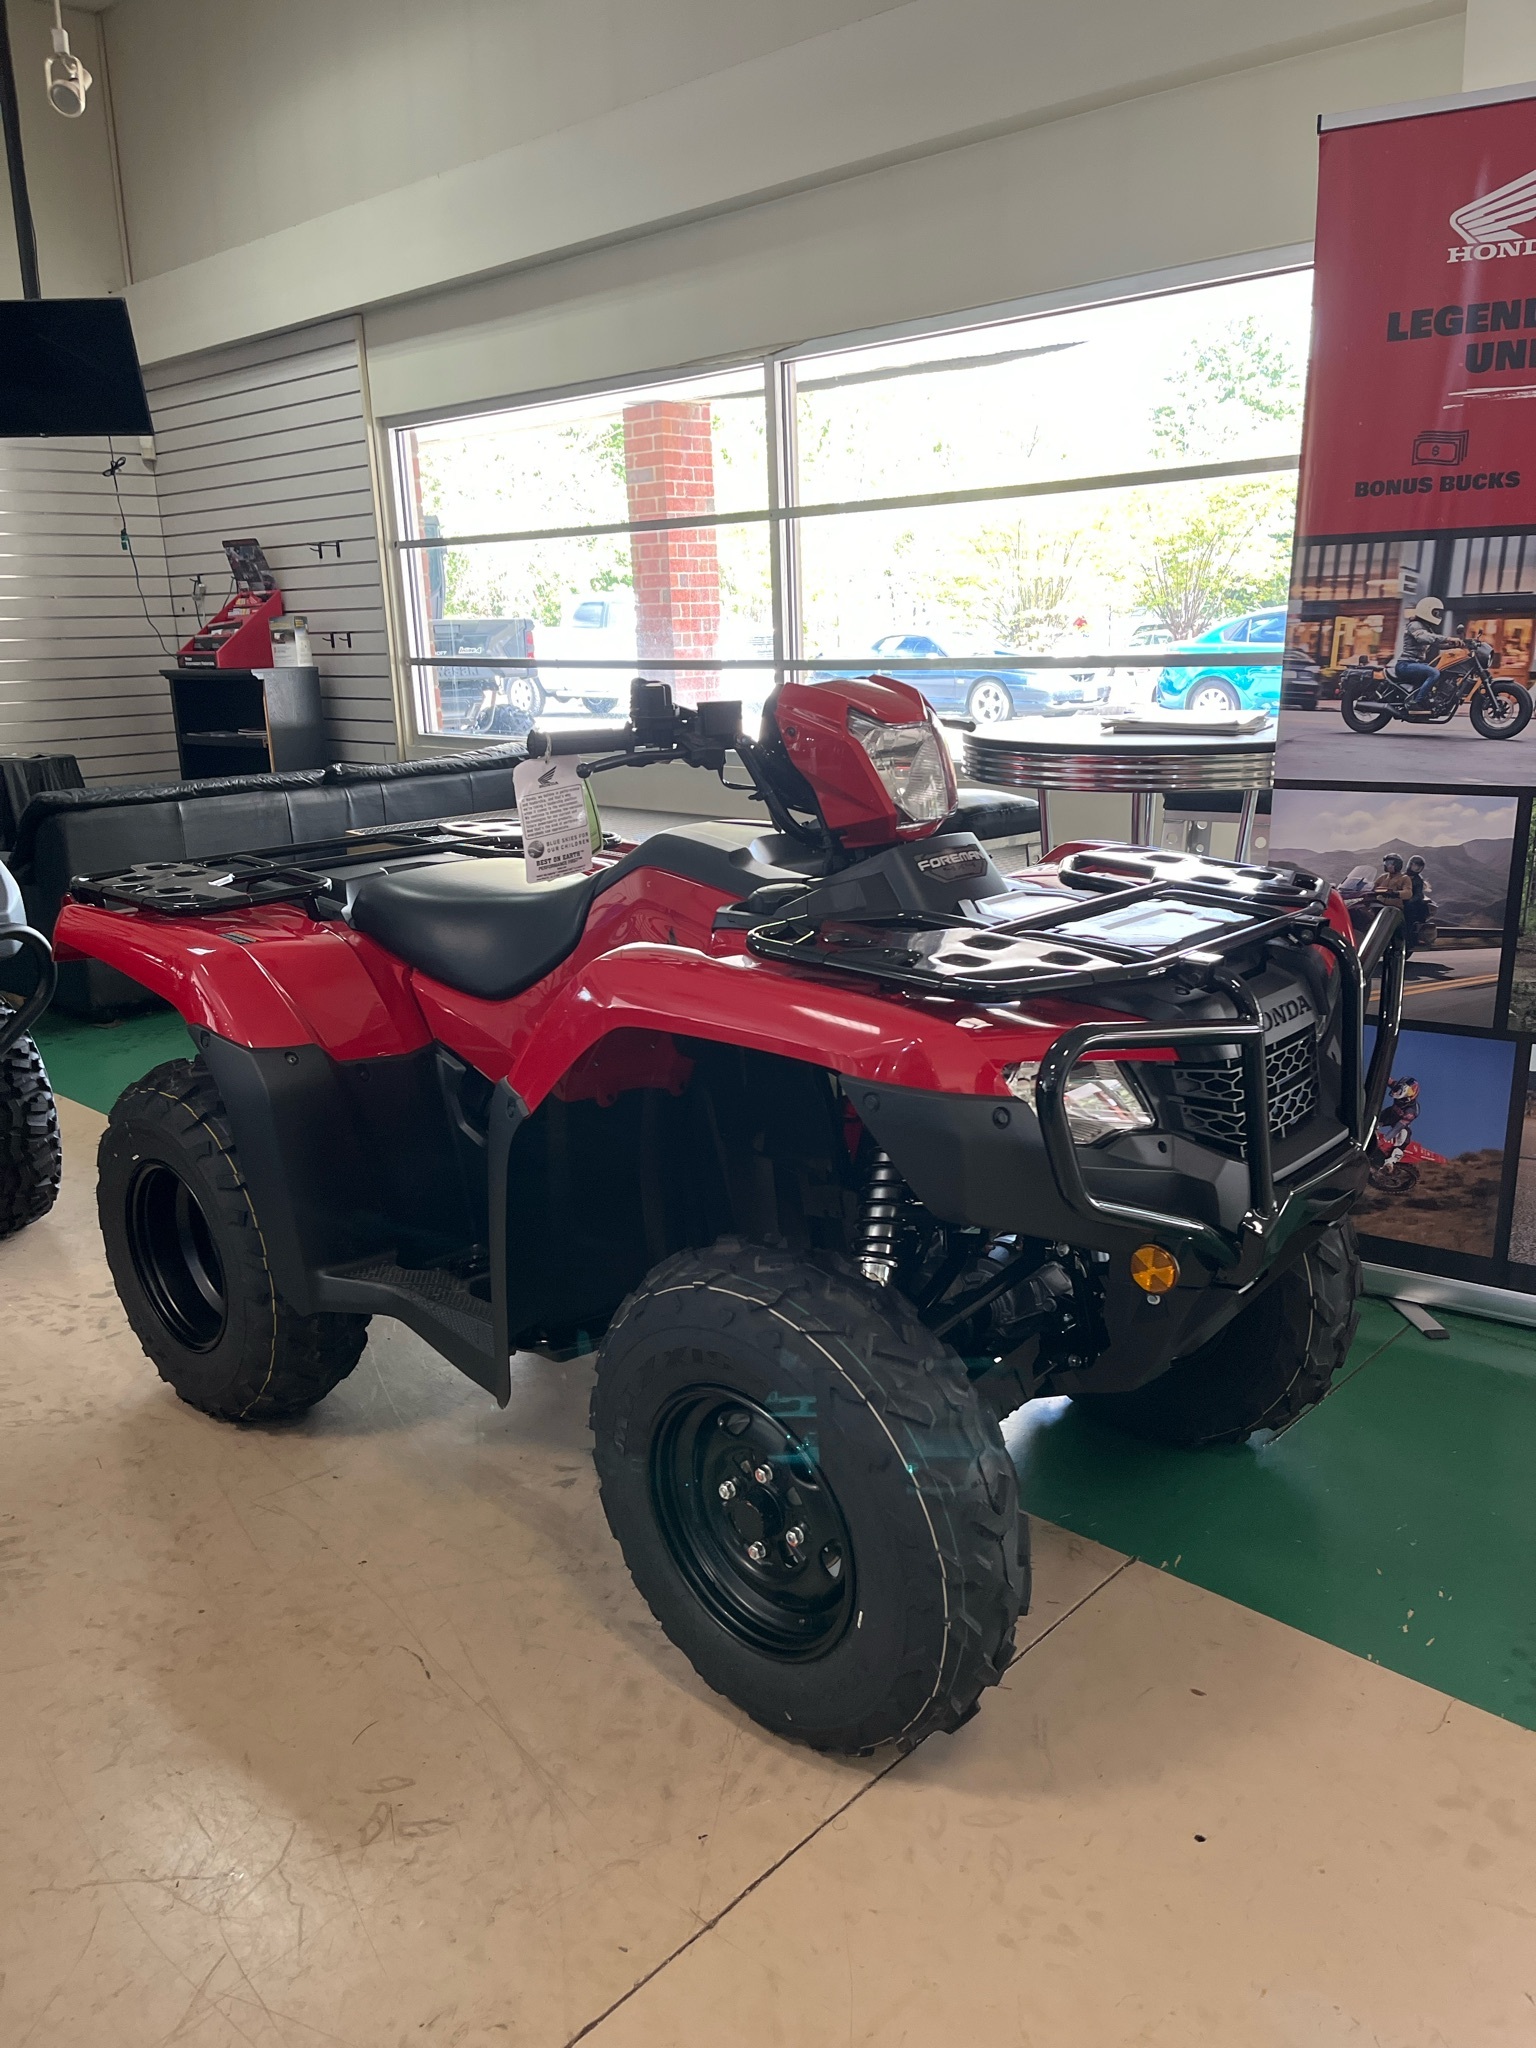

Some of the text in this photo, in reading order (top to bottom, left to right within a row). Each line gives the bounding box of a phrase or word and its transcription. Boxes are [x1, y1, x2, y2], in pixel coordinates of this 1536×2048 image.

[1355, 471, 1521, 498] BONUS BUCKS
[546, 838, 560, 847] BLUE
[562, 835, 578, 843] SKIES
[561, 838, 590, 850] CHILDREN
[536, 858, 552, 866] BEST
[917, 851, 984, 872] FOREMAN
[1263, 995, 1312, 1032] ONDA
